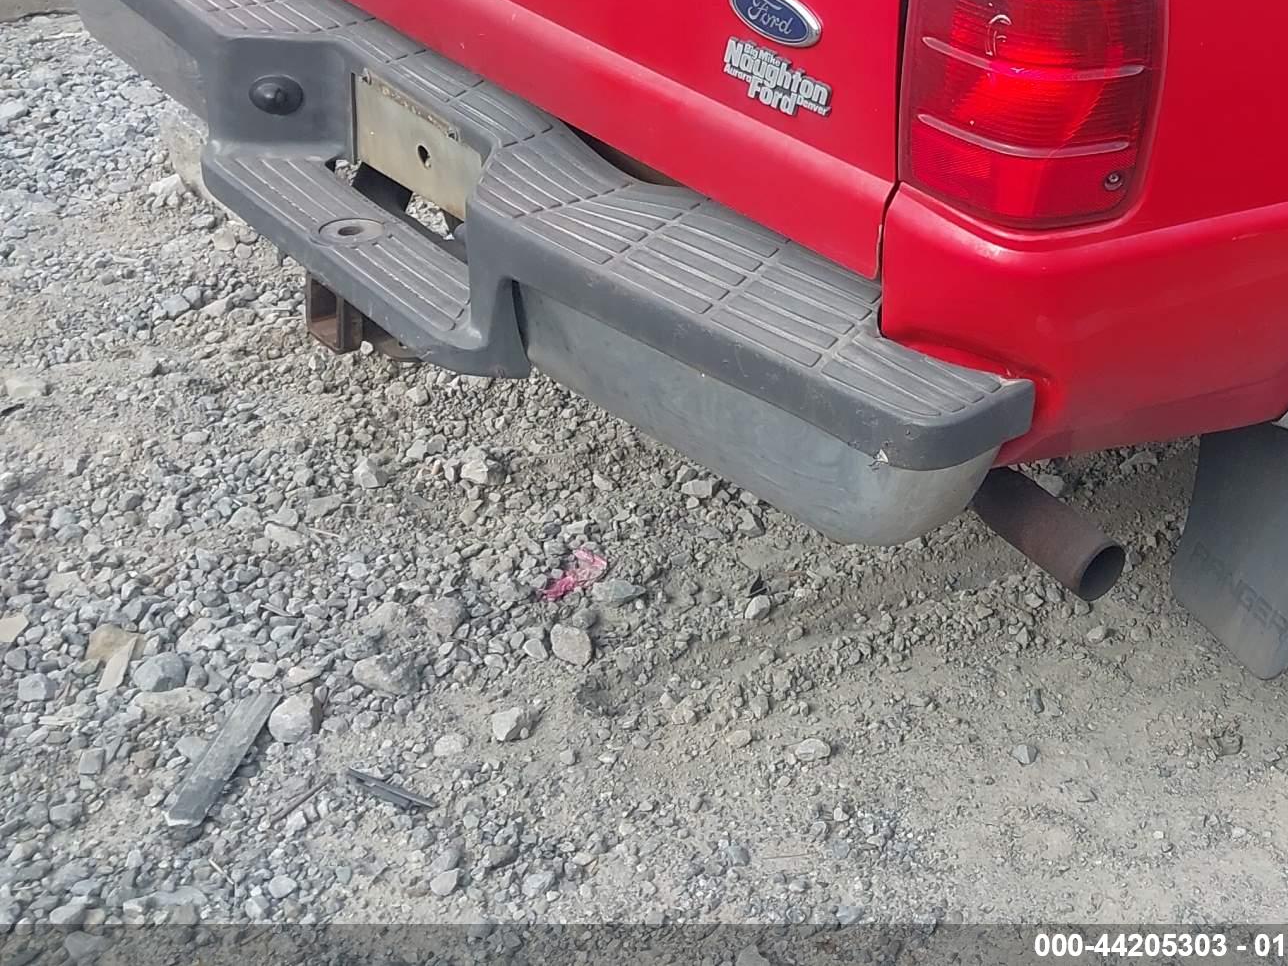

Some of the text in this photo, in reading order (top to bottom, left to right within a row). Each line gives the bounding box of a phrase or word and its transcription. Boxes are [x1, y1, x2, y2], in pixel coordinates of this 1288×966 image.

[723, 37, 831, 105] Naughton
[748, 75, 797, 116] Ford
[796, 94, 832, 116] Denver
